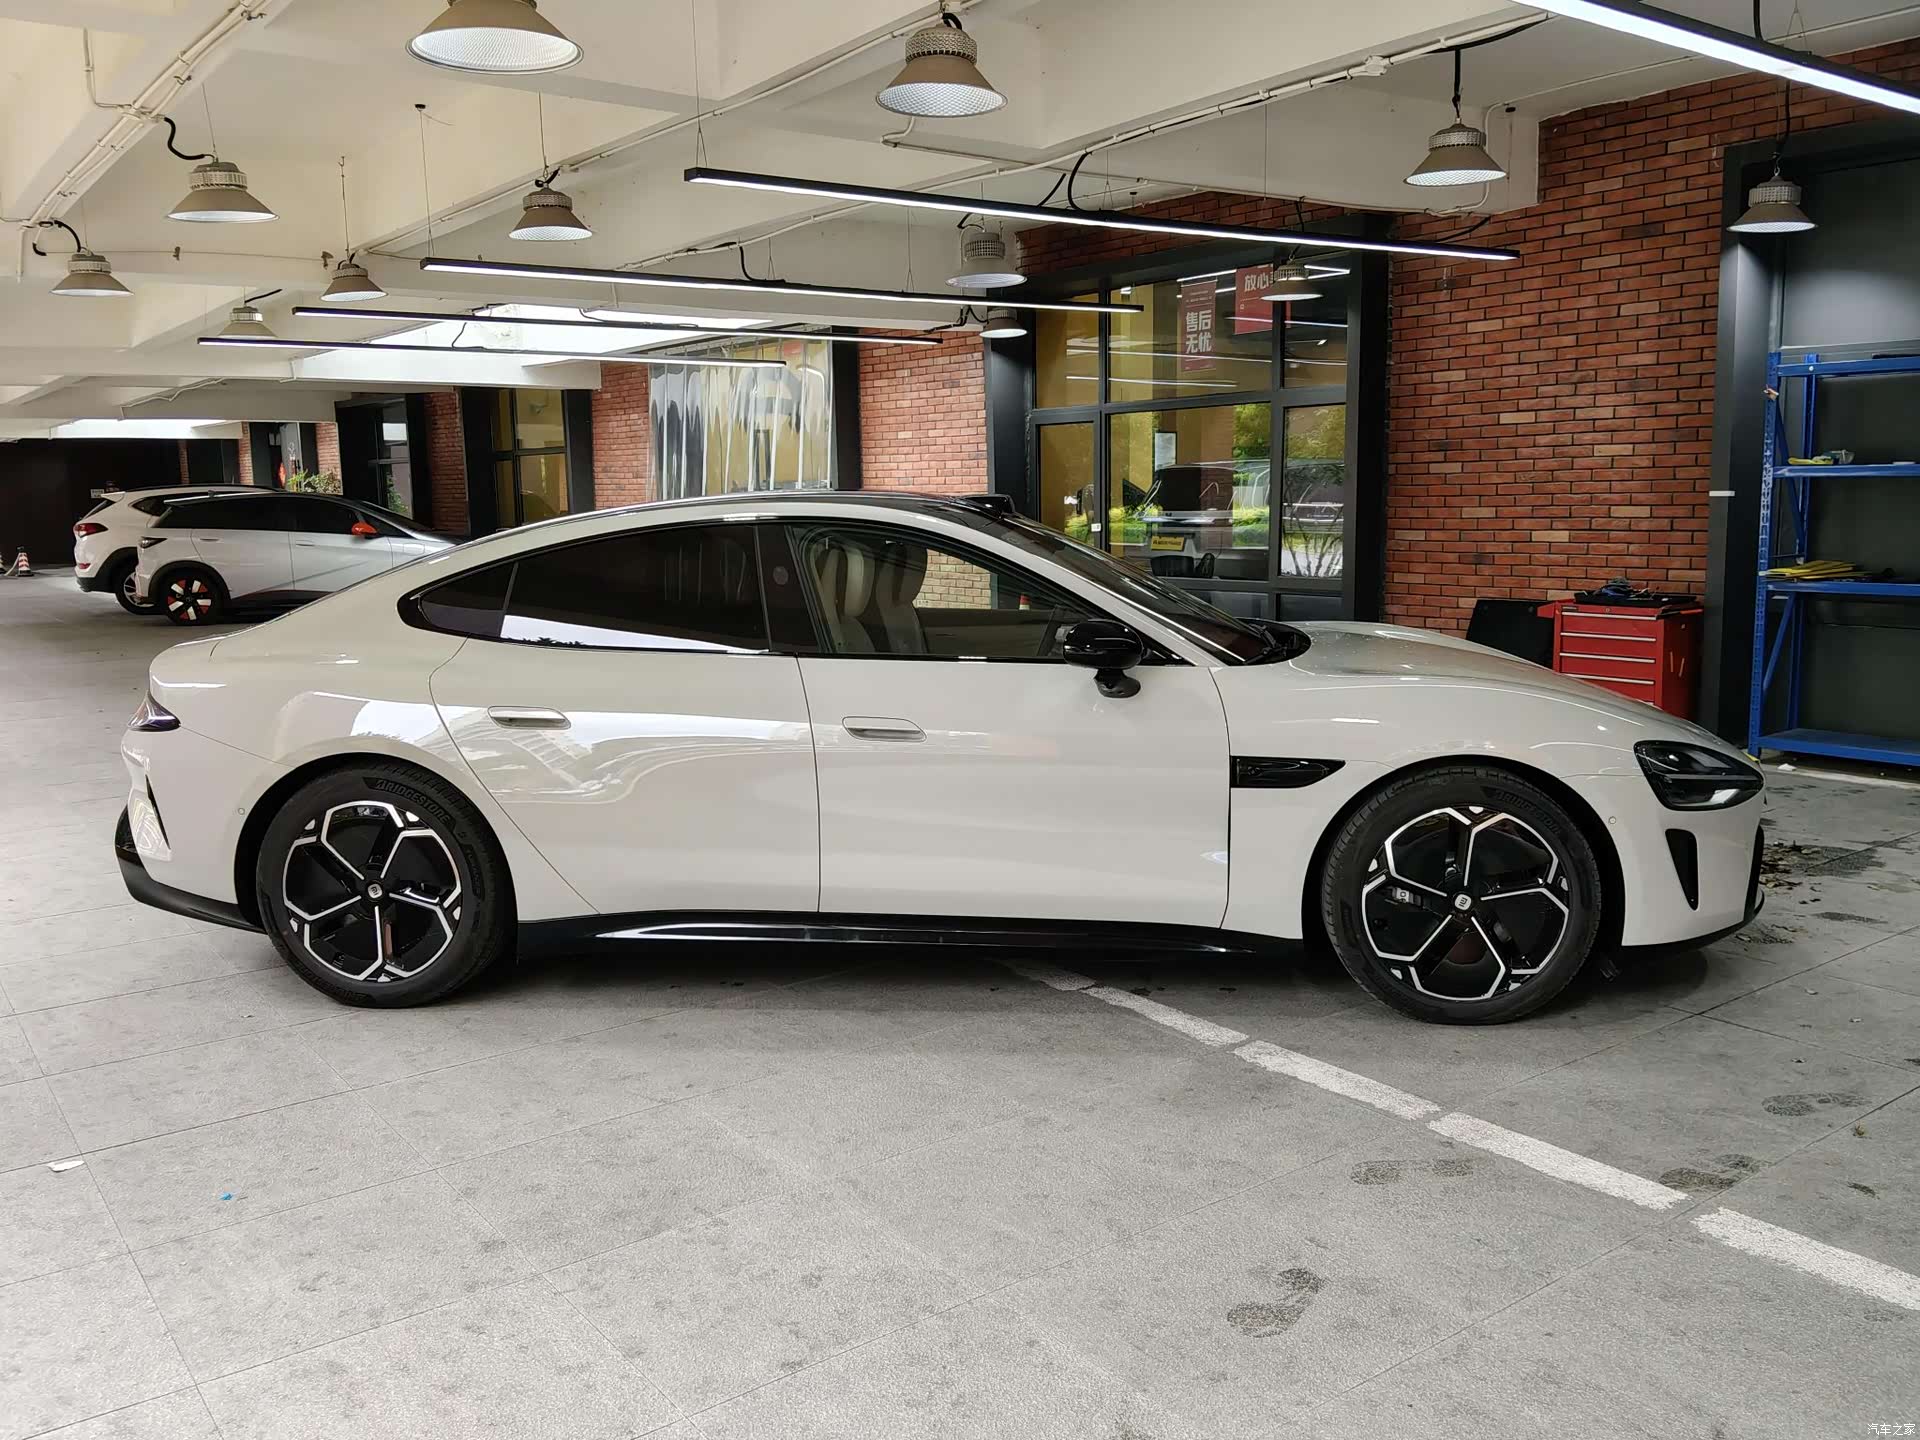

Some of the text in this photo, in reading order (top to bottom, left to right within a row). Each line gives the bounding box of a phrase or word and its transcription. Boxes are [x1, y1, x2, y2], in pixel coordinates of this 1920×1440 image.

[1186, 309, 1212, 333] 售后
[1186, 332, 1212, 354] 无忧
[375, 779, 451, 824] BRIDGESTONE
